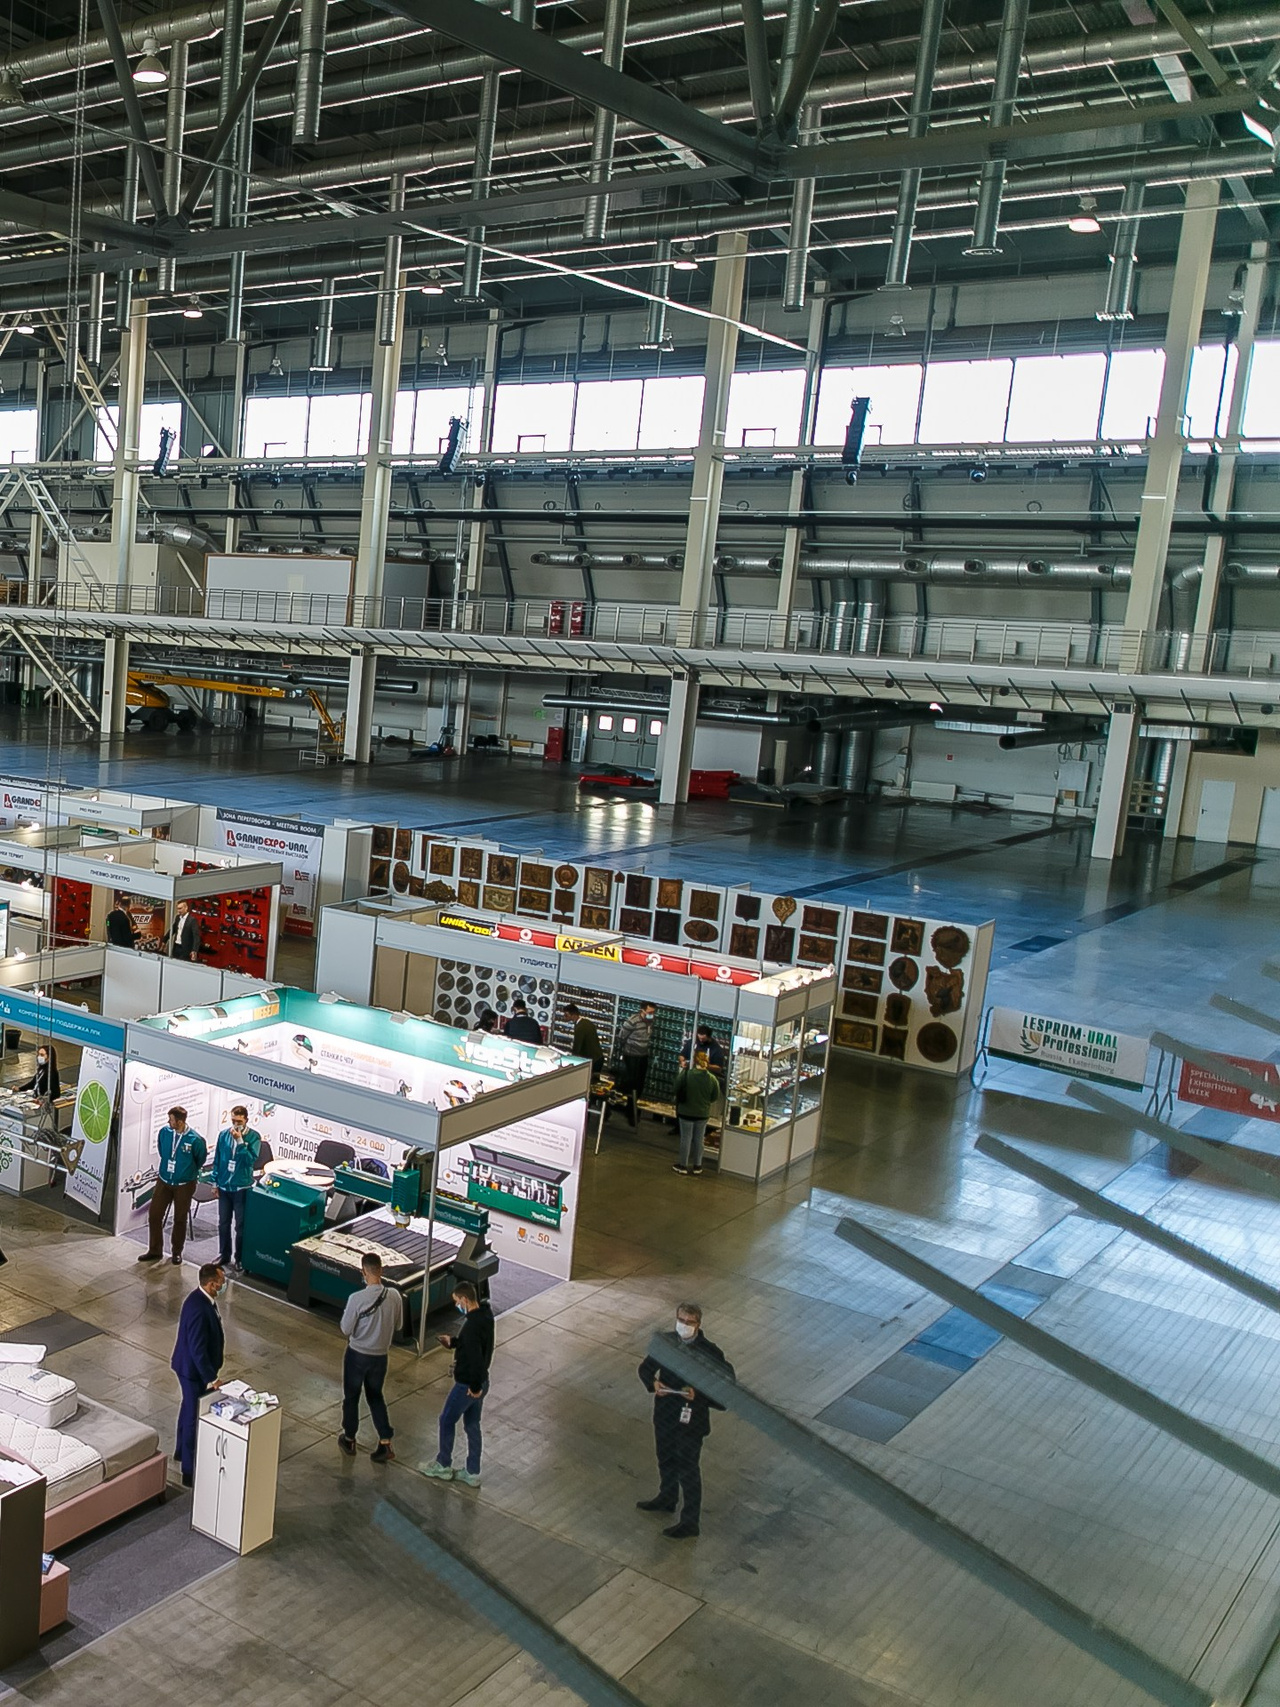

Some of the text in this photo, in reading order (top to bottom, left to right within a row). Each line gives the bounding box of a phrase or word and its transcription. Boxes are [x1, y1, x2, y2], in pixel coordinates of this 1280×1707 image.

[222, 812, 236, 820] ЗОНА
[237, 814, 270, 826] ПЕРЕГОВОРОВ
[276, 821, 298, 831] MEETING
[299, 825, 317, 834] ROOM
[238, 842, 308, 859] НЕДЕЛЯ ОТРАСЛЕВЫХ ВЫСТАВОК
[520, 956, 558, 970] ТУЛДИРЕКТ
[55, 1018, 90, 1034] ПОДДЕРЖКА
[1022, 1015, 1117, 1049] LESPROM URAL
[1042, 1034, 1117, 1064] Professional
[1068, 1057, 1115, 1075] Ekaterinburg
[247, 1072, 296, 1094] ТОПСТАНКИ
[1187, 1087, 1210, 1098] WEEK
[357, 1135, 386, 1152] 24 000
[537, 1232, 551, 1244] 50
